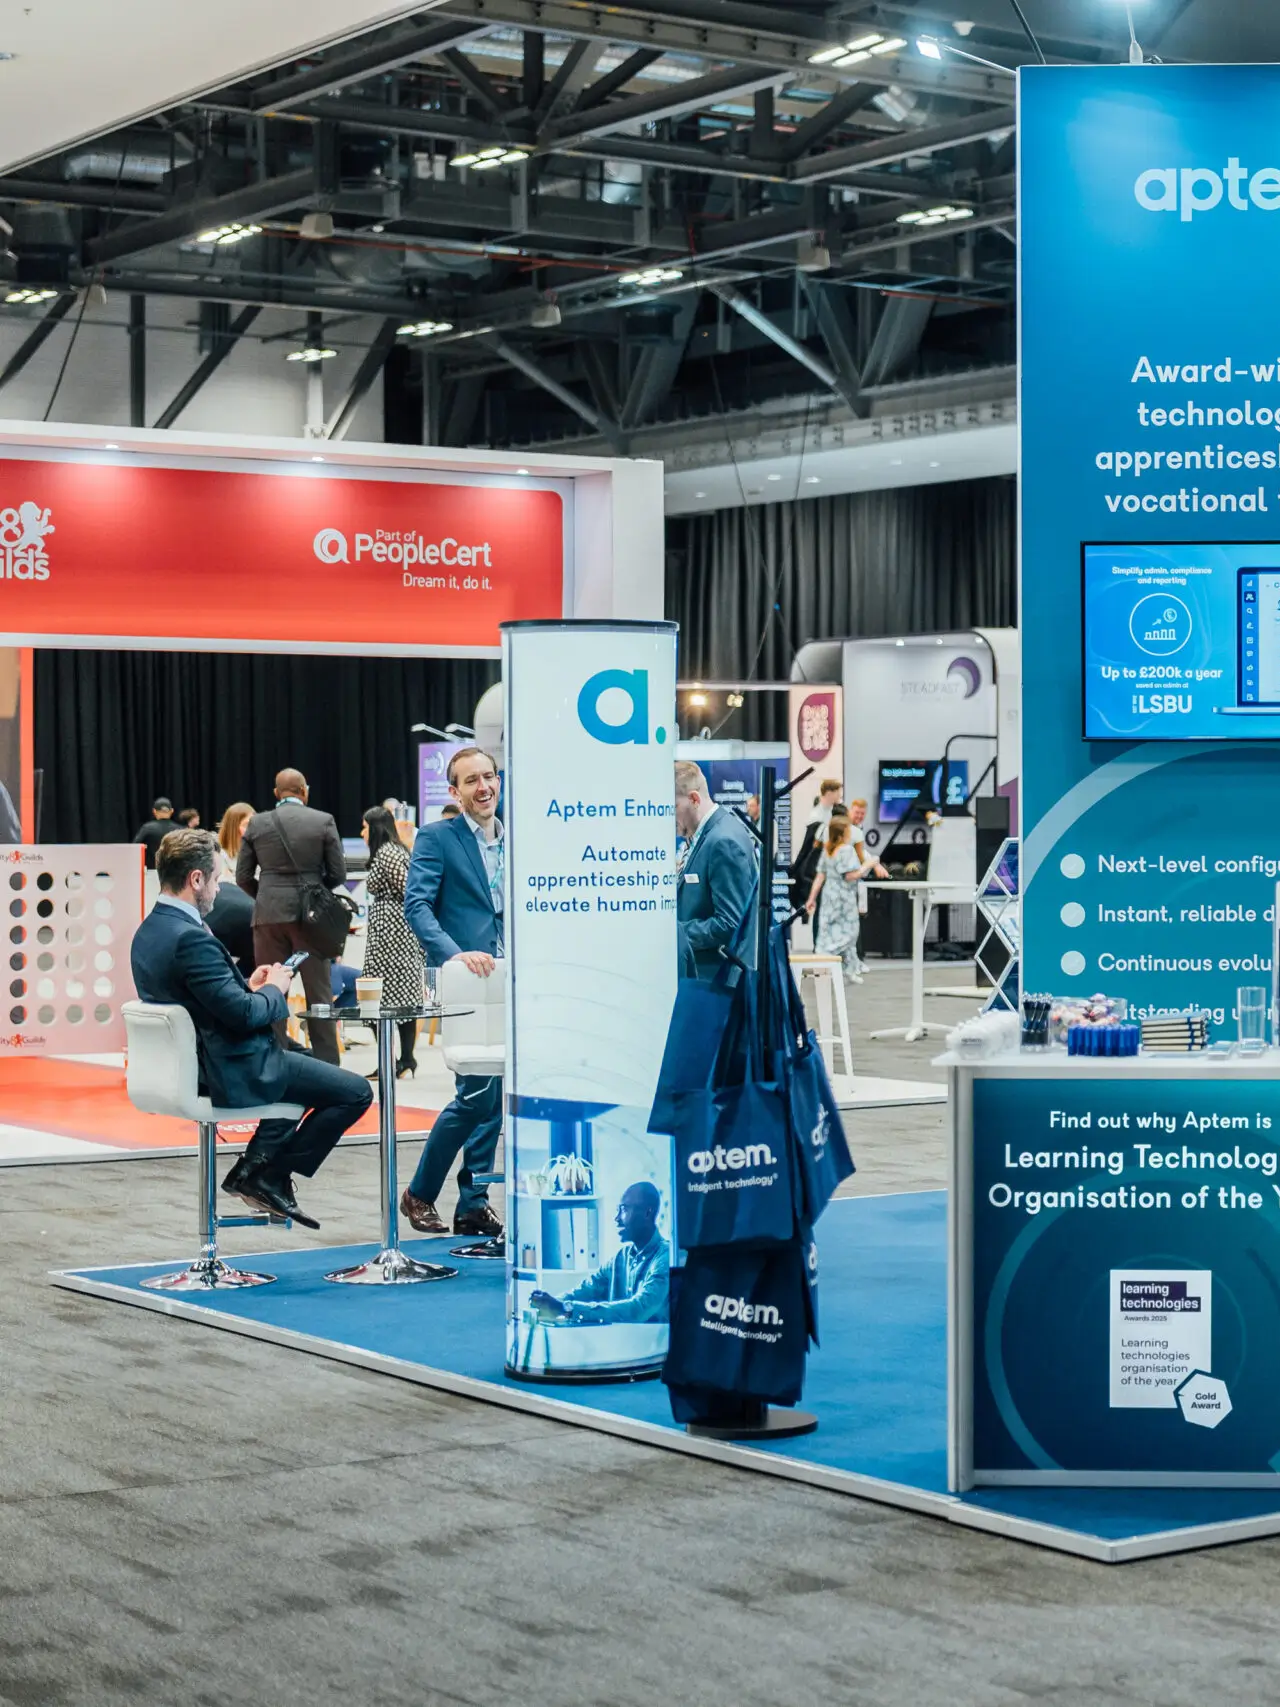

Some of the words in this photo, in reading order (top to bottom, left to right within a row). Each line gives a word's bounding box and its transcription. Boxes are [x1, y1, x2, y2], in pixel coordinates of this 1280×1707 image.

[1105, 487, 1268, 512] vocational
[375, 529, 401, 541] Part
[404, 530, 416, 542] of
[355, 534, 492, 570] PeopleCert
[1112, 566, 1143, 575] Simplify
[1170, 566, 1212, 576] compliance
[403, 573, 446, 588] Dream
[449, 574, 460, 591] it,
[463, 576, 479, 589] do
[482, 576, 492, 590] it.
[1138, 576, 1152, 584] and
[1153, 576, 1187, 586] reporting
[1101, 666, 1120, 681] Up
[1123, 667, 1137, 678] to
[1140, 666, 1182, 678] £200k
[1185, 669, 1193, 678] a
[1196, 669, 1223, 681] year
[900, 681, 960, 695] STEADFAST
[1140, 695, 1193, 713] LSBU
[546, 799, 617, 822] Aptem
[581, 845, 666, 862] Automate
[1098, 855, 1208, 873] Next-level
[528, 871, 660, 891] apprenticeship
[525, 896, 590, 912] elevate
[597, 896, 657, 912] human
[1098, 904, 1173, 924] Instant,
[1180, 905, 1257, 922] reliable
[1098, 953, 1213, 971] Continuous
[1218, 954, 1272, 971] evolu
[1122, 1003, 1225, 1024] utstanding
[1049, 1110, 1092, 1129] Find
[1097, 1113, 1130, 1129] out
[1136, 1111, 1177, 1133] why
[1183, 1111, 1249, 1133] Aptem
[1255, 1112, 1272, 1129] is
[1004, 1144, 1124, 1175] Learning
[988, 1183, 1172, 1215] Organisation
[1181, 1184, 1209, 1209] of
[1218, 1185, 1263, 1209] the
[1122, 1283, 1170, 1297] learning
[1122, 1297, 1199, 1311] technologies
[1121, 1338, 1169, 1349] Learning
[1121, 1351, 1191, 1362] technologies
[1120, 1363, 1188, 1375] organisation
[1120, 1376, 1132, 1385] of
[1134, 1376, 1153, 1385] the
[1155, 1379, 1177, 1388] year
[1195, 1392, 1217, 1400] Gold
[1190, 1401, 1221, 1410] Award
